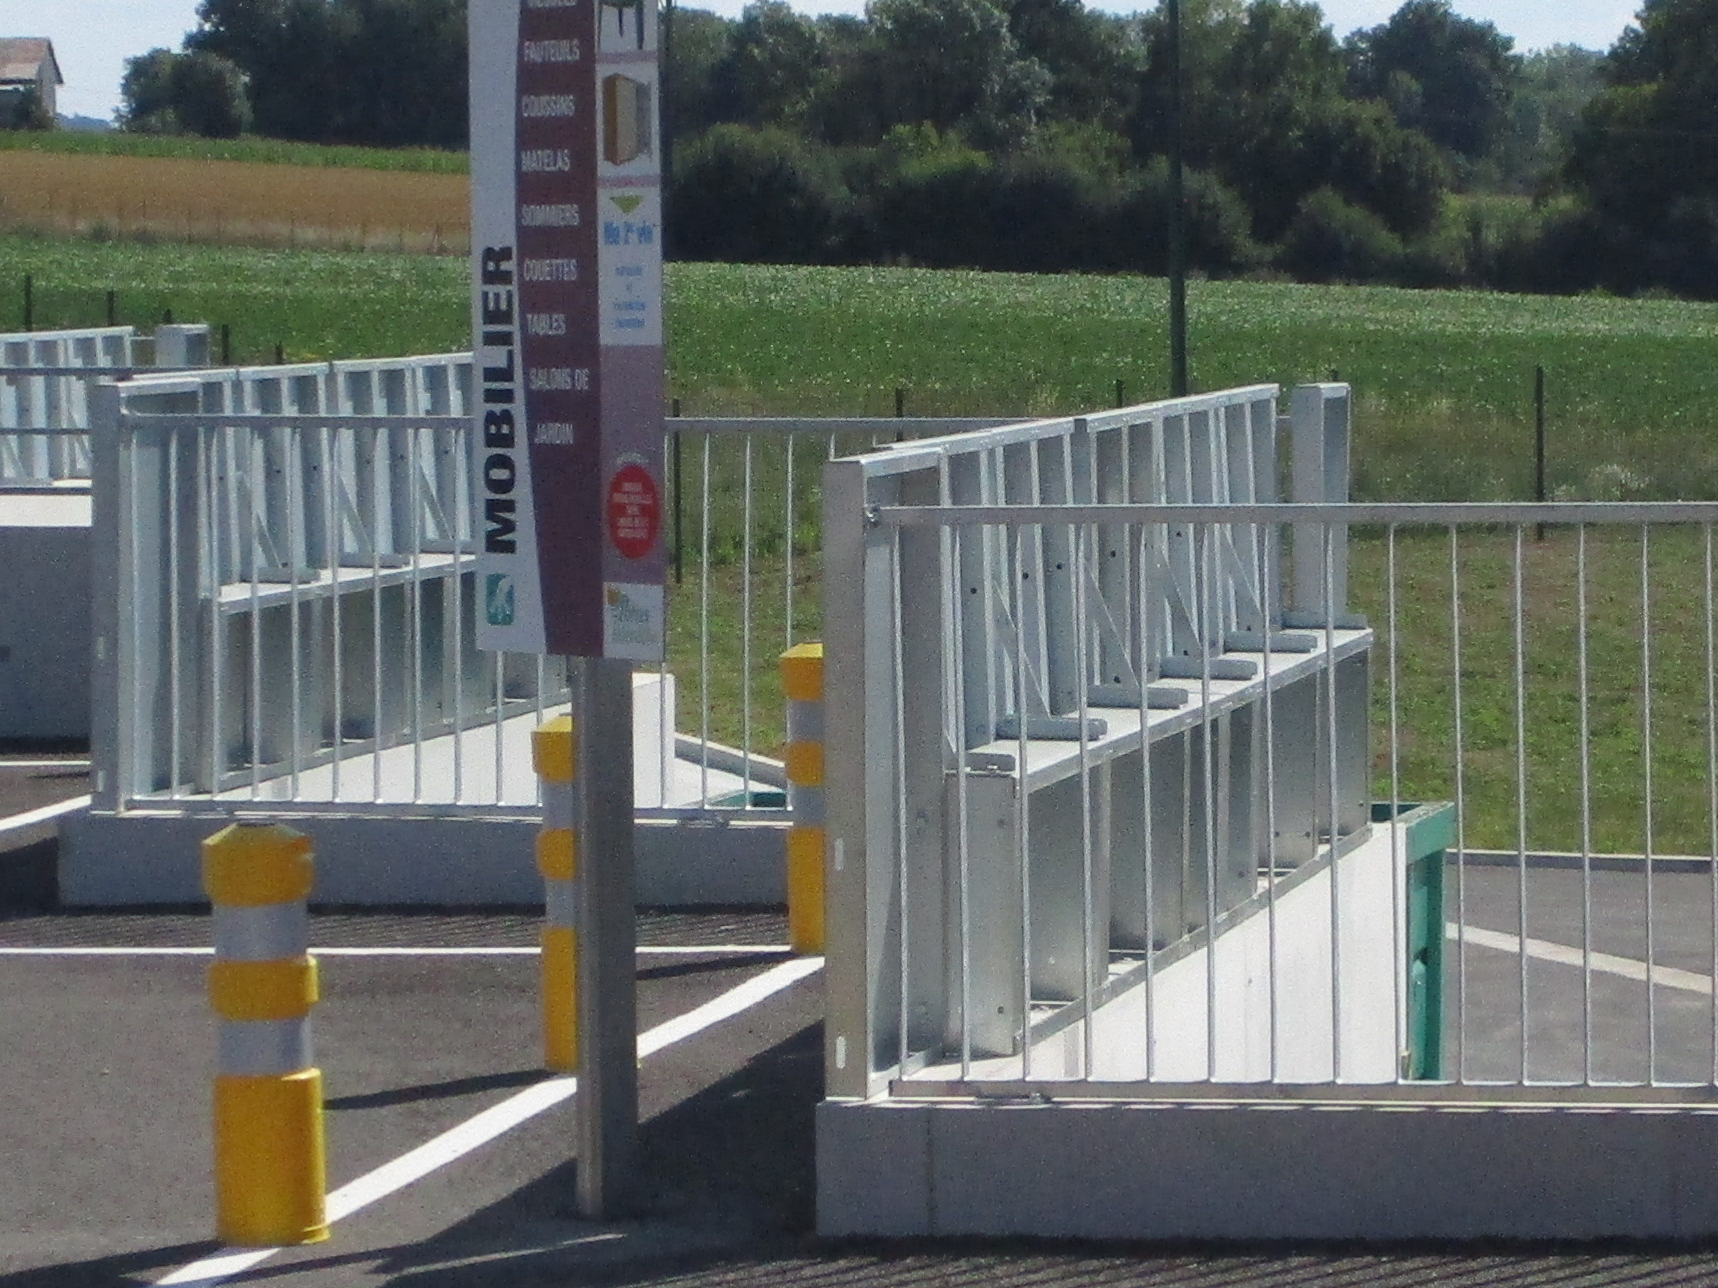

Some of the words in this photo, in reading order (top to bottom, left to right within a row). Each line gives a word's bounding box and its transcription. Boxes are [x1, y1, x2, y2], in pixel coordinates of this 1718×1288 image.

[524, 38, 581, 62] FAUTEUILS
[521, 149, 571, 172] MATELAS
[523, 258, 578, 281] COUETTES
[527, 313, 566, 336] TABLES
[529, 368, 571, 391] SALONS
[574, 367, 590, 391] DE
[482, 246, 517, 554] MOBILIER
[534, 422, 574, 445] JARDIN
